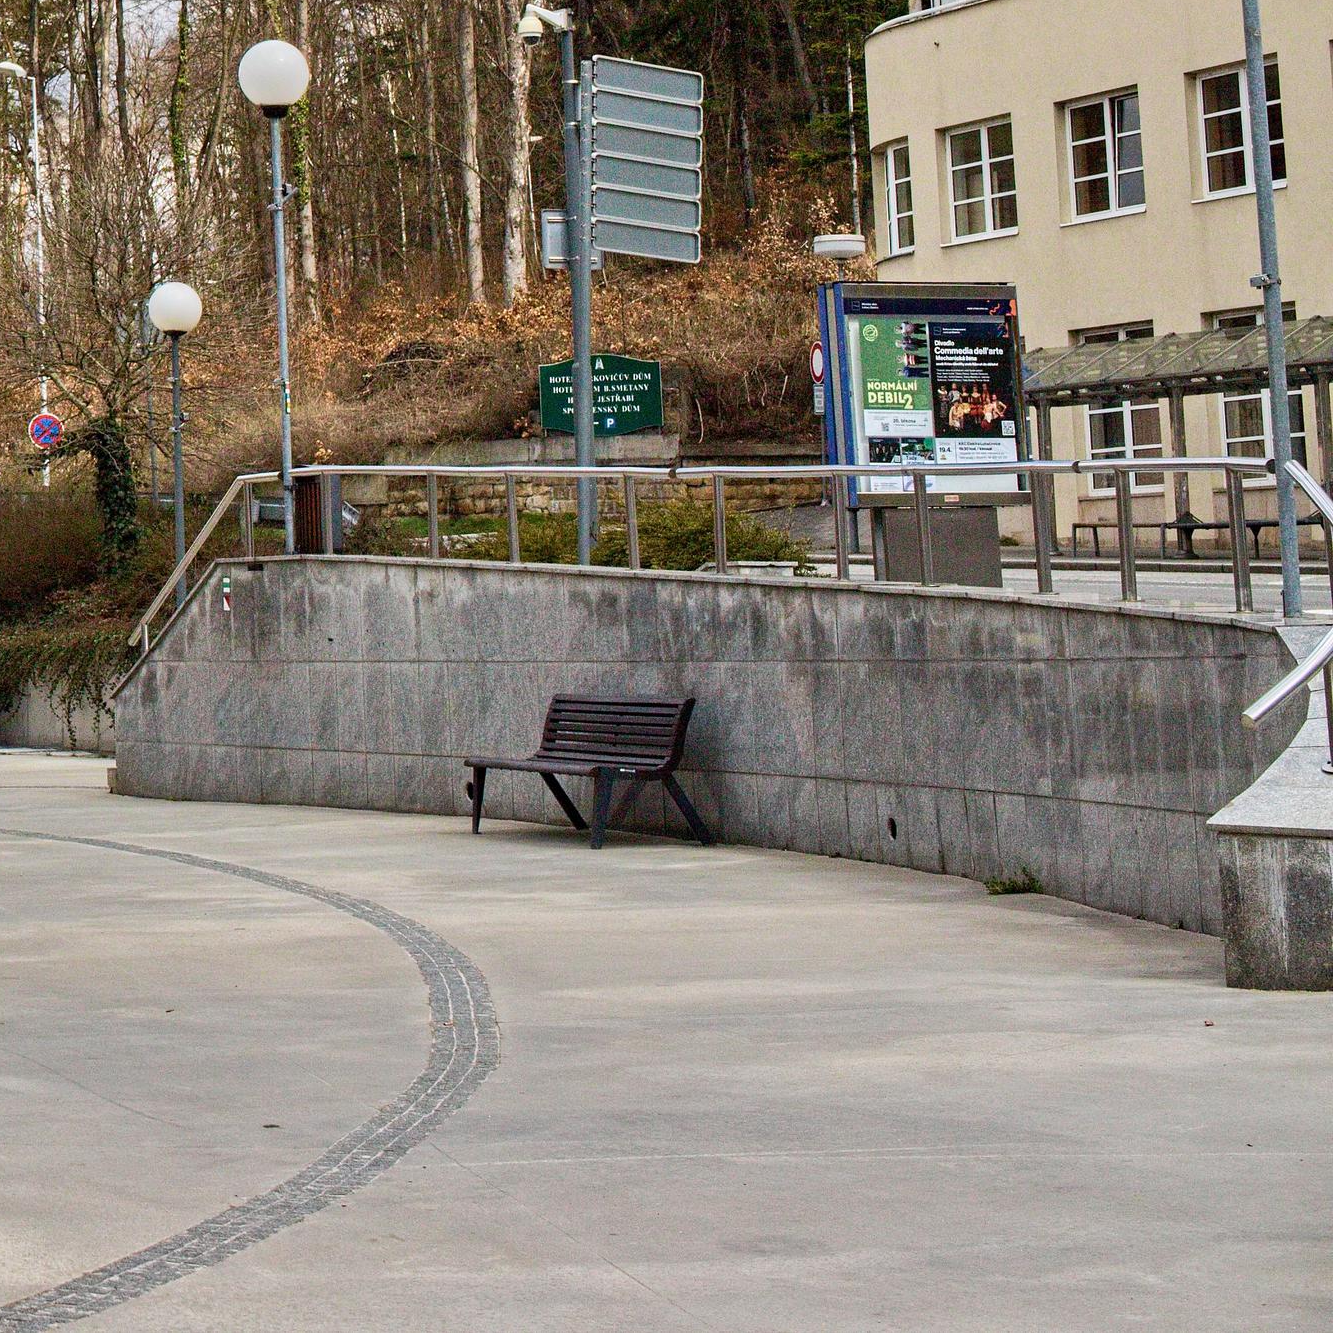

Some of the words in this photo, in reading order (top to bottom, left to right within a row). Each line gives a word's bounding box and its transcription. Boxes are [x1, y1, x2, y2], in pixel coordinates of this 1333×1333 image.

[934, 347, 973, 355] Commedia
[549, 375, 574, 383] HOTE
[633, 371, 652, 380] DŮM
[553, 386, 574, 394] HOTE
[866, 380, 918, 391] NORMÁLNÍ
[621, 404, 641, 413] DŮM
